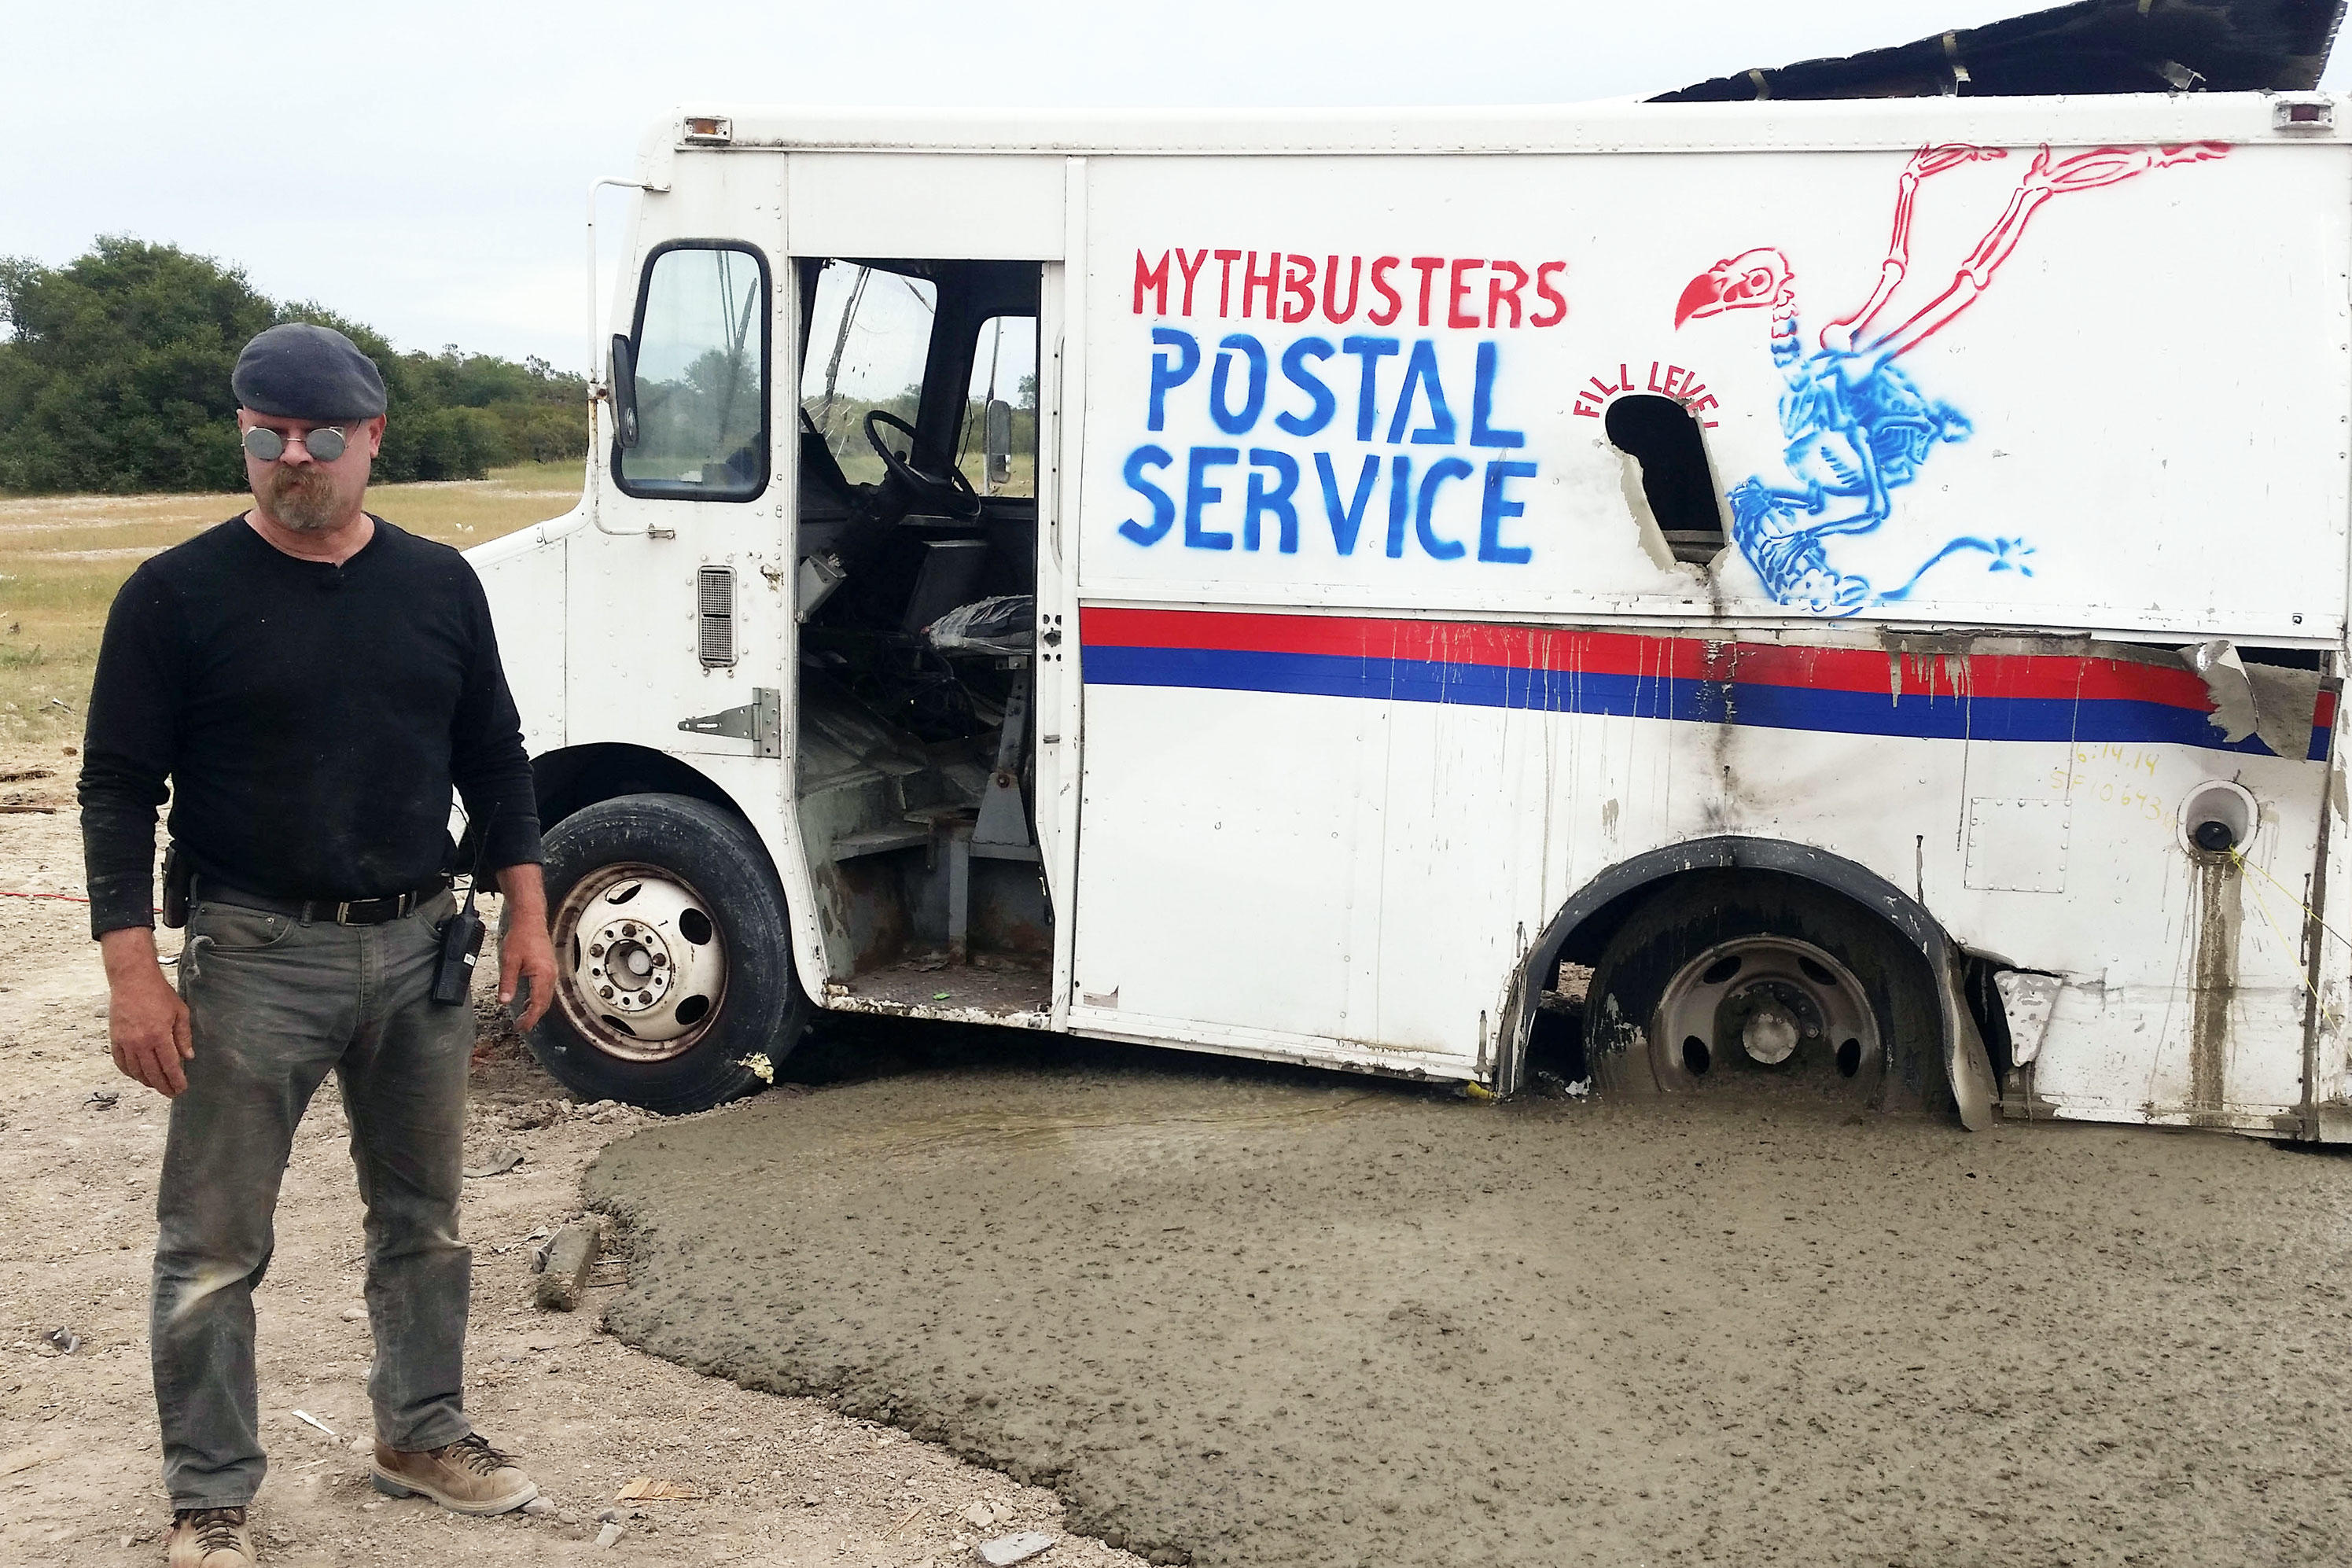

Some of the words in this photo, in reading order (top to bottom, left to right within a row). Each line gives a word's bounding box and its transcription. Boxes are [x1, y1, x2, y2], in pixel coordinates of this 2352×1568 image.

[1132, 247, 1567, 329] MYTHBUSTERS
[1147, 327, 1525, 448] POSTAL
[1573, 363, 1635, 418] FILL
[1117, 444, 1538, 565] SERVICE
[2076, 742, 2159, 778] 6.14.14
